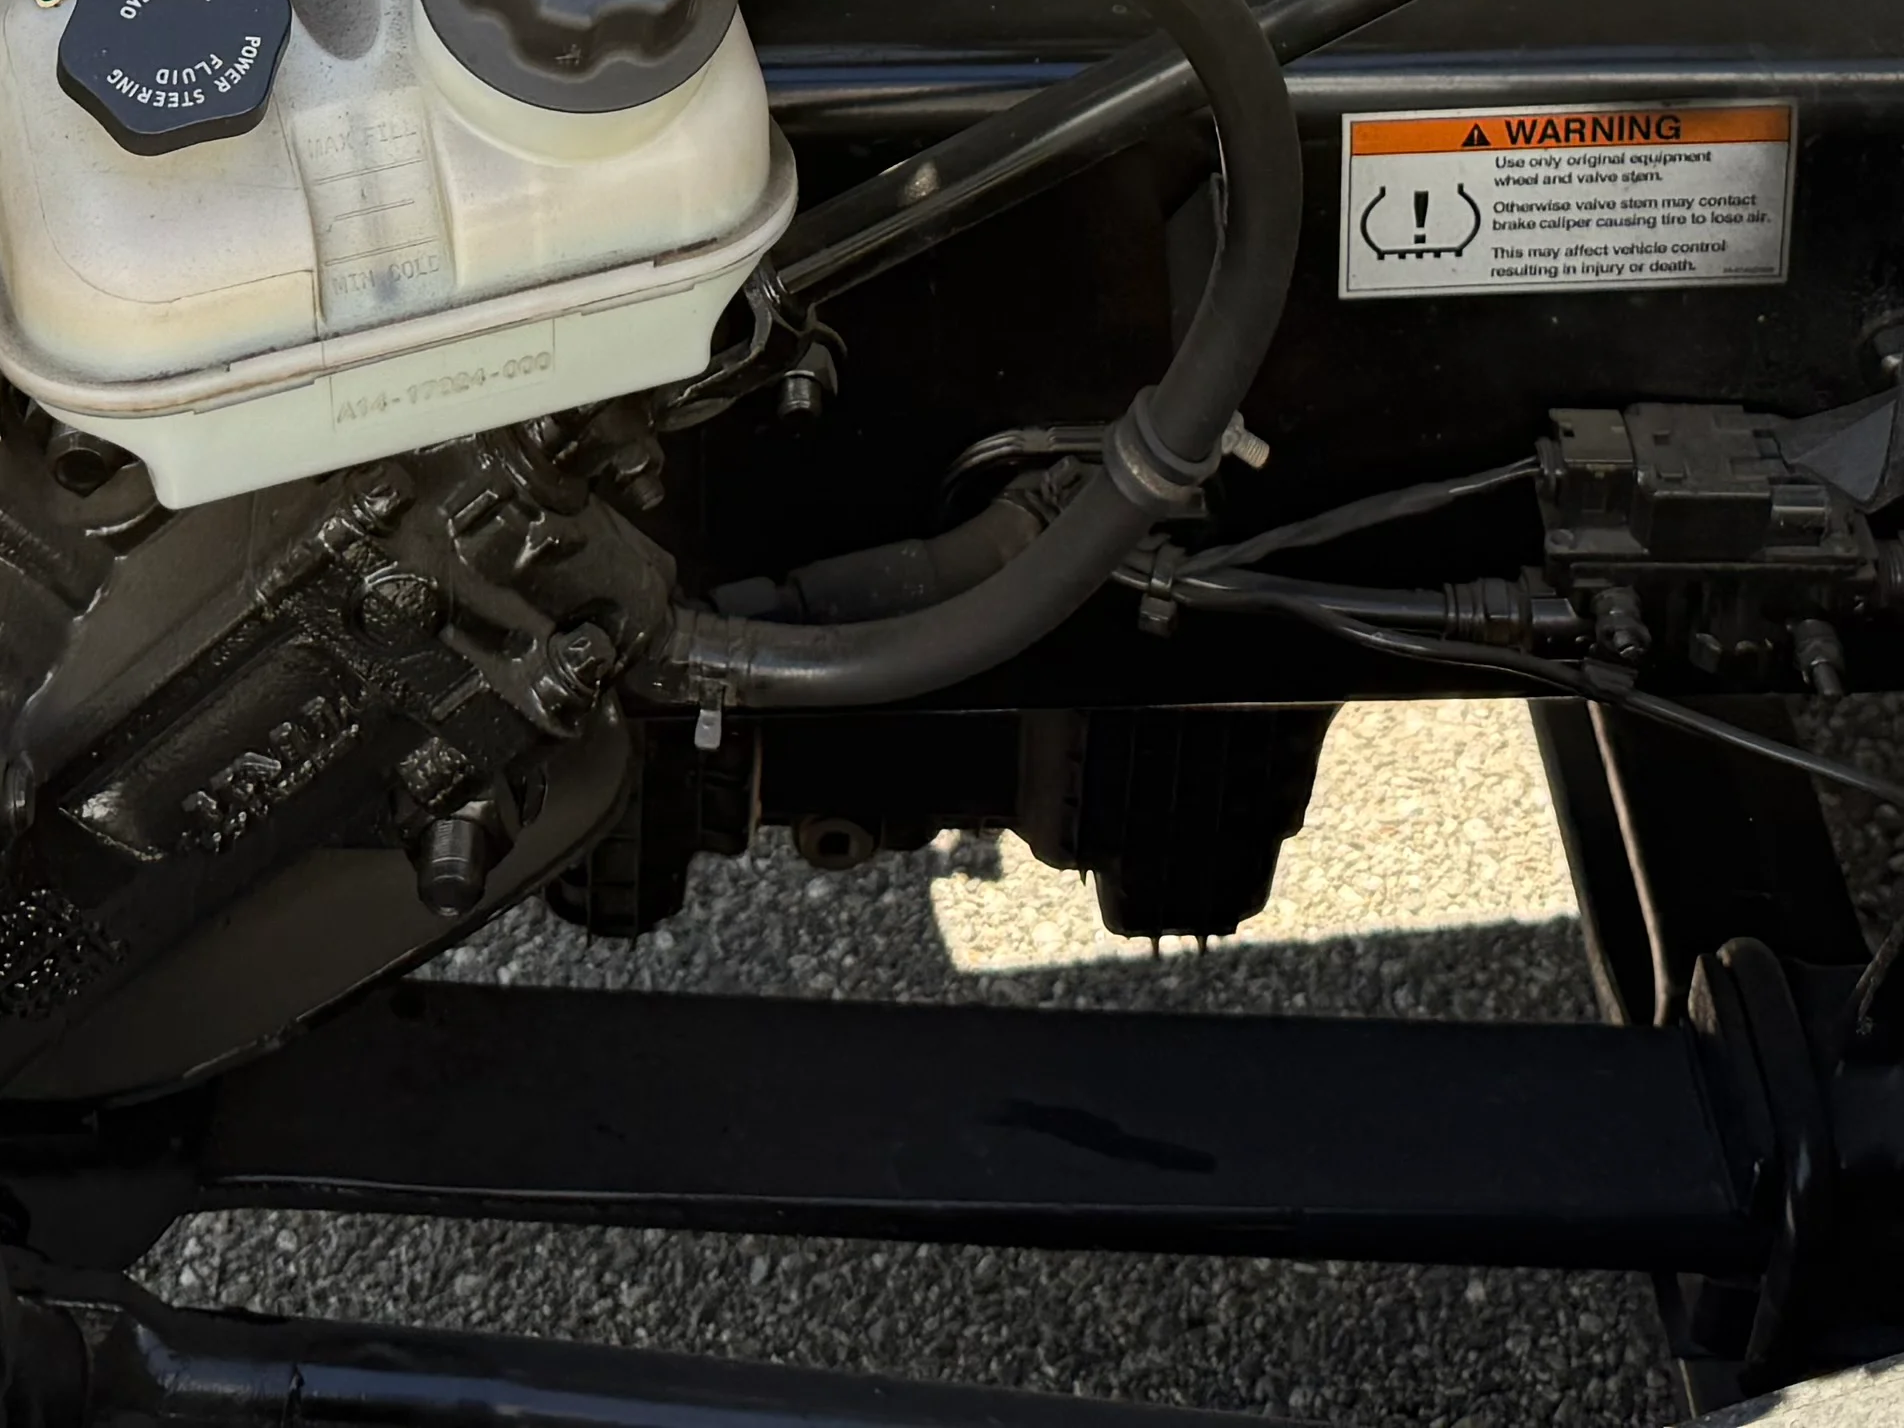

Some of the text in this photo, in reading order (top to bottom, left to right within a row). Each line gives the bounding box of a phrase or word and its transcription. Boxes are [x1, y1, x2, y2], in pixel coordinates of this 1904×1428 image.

[106, 35, 261, 108] POWER STEERING
[155, 52, 224, 85] FLUID
[1505, 114, 1682, 146] WARNING
[1495, 149, 1712, 172] Use only original equipment
[1494, 169, 1663, 186] wheel and valve stem.
[1493, 193, 1757, 214] Otherwise valve stem may contact
[1492, 207, 1772, 233] brake caliper causing tire to lose air.
[1492, 238, 1727, 262] This may affect vehicle control
[332, 254, 441, 295] MIN COLD
[1490, 257, 1696, 280] resulting in injury or death.
